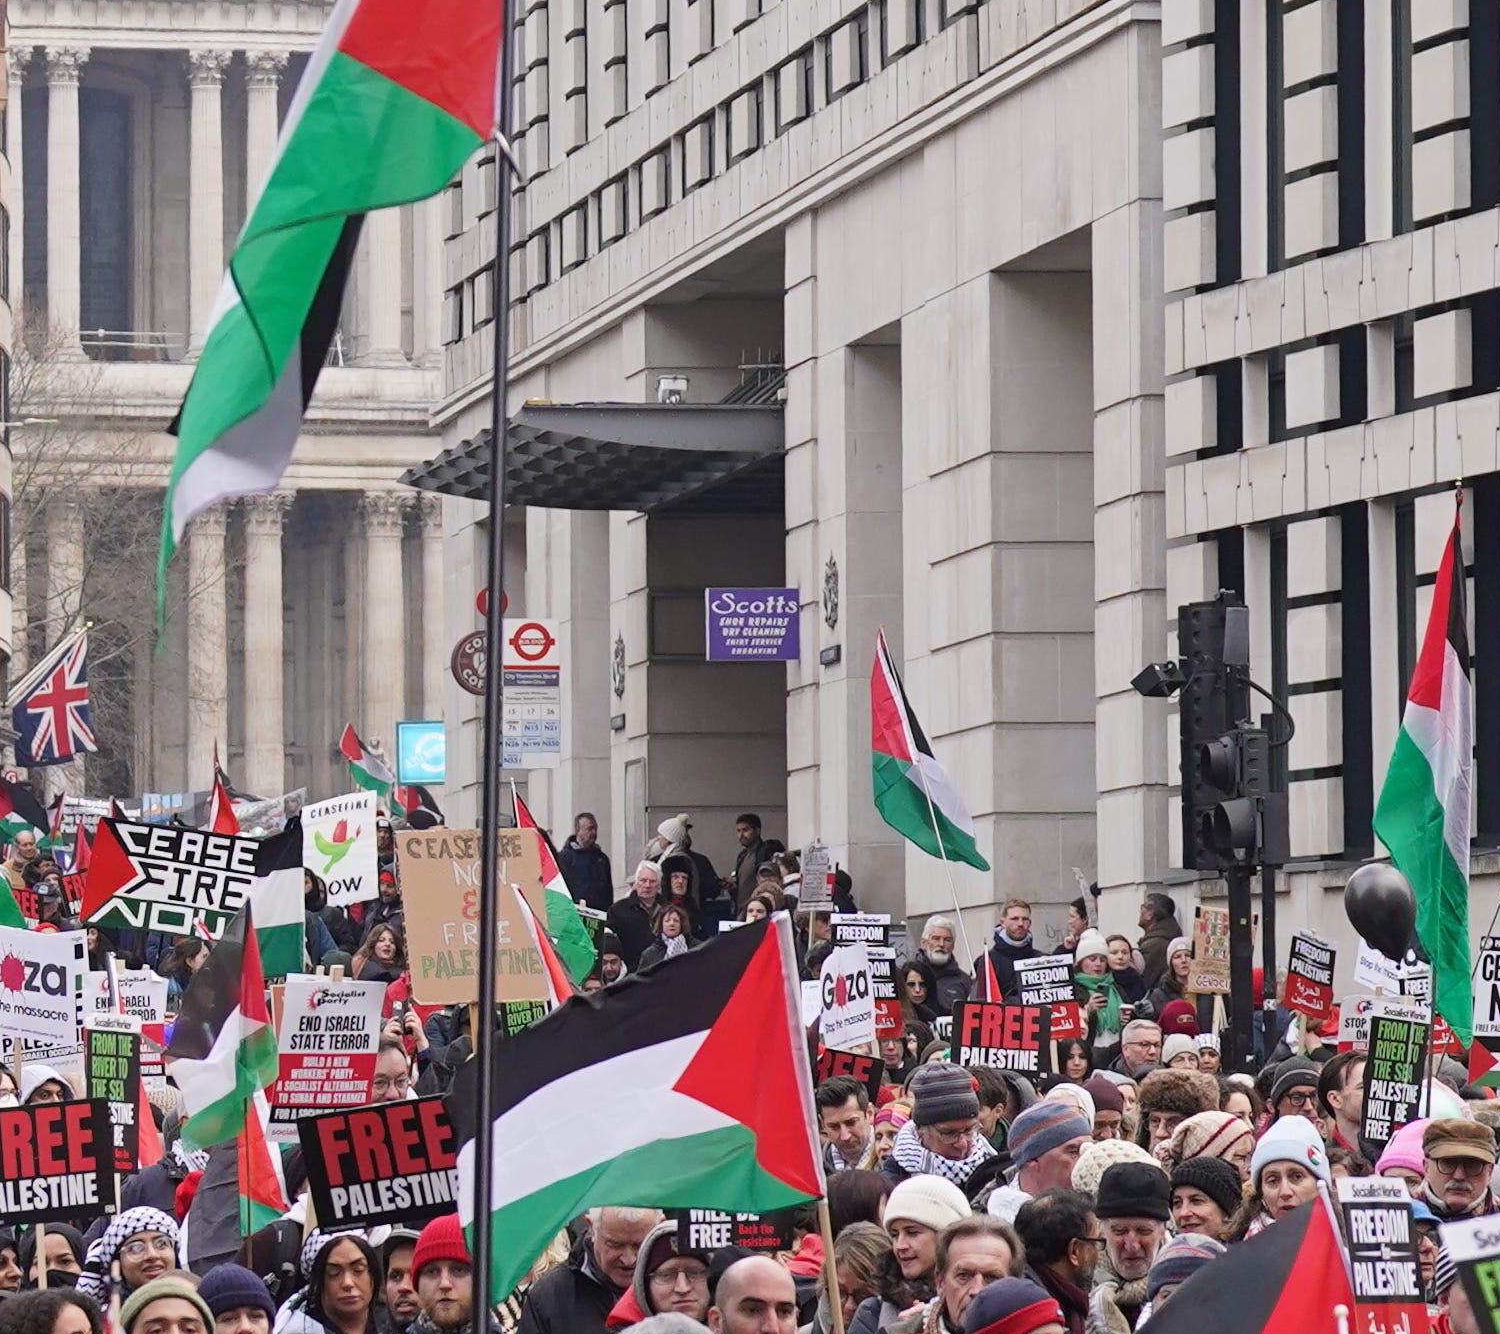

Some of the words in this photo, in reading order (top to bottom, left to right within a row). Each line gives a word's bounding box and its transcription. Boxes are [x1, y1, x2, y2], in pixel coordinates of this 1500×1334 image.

[711, 593, 798, 614] Scotts
[719, 617, 745, 626] SHOE
[748, 617, 789, 626] REPAIRS
[722, 628, 740, 636] DRY
[743, 628, 786, 636] CLEANING
[726, 638, 749, 646] SHIRT
[310, 799, 368, 819] CEASEFIRE
[116, 823, 260, 874] CEASE
[407, 835, 522, 860] CEASERE
[442, 920, 511, 945] FRE
[837, 926, 883, 941] FREEDOM
[1295, 940, 1331, 964] FREEDOM
[422, 948, 543, 979] PALETINE
[1291, 959, 1331, 984] PALESTINE
[1021, 967, 1069, 984] FREEDOM
[321, 988, 366, 1000] Socialist
[822, 969, 869, 1012] Gza
[1022, 986, 1074, 1005] PALESTINE
[14, 1004, 69, 1022] massacre
[508, 1009, 532, 1025] RIVER
[1345, 1018, 1367, 1029] STOP
[299, 1017, 322, 1032] END
[325, 1016, 366, 1031] ISRAELI
[962, 1004, 1040, 1049] FREE
[1378, 1020, 1407, 1040] FROM
[92, 1034, 115, 1057] FROM
[117, 1034, 133, 1056] THE
[290, 1035, 324, 1050] STATE
[326, 1034, 370, 1050] TERROR
[1376, 1040, 1405, 1061] RIVER
[92, 1057, 117, 1079] RIVER
[118, 1057, 128, 1078] TO
[960, 1046, 1039, 1071] PALESTINE
[330, 1069, 353, 1079] PARTY
[1374, 1061, 1391, 1080] THE
[1394, 1063, 1413, 1082] SEA
[92, 1078, 106, 1099] THE
[108, 1078, 125, 1100] SEA
[284, 1081, 322, 1091] SOCIALIST
[324, 1080, 368, 1091] ALTERNATIVE
[1370, 1080, 1419, 1103] PALESTINE
[1368, 1099, 1391, 1120] WILL
[1395, 1103, 1408, 1122] BE
[1365, 1119, 1390, 1140] FREE
[317, 1099, 456, 1186] FREE
[690, 1224, 732, 1249] FREE
[1351, 1209, 1410, 1244] FREEDOM
[1354, 1262, 1421, 1297] PALESTINE
